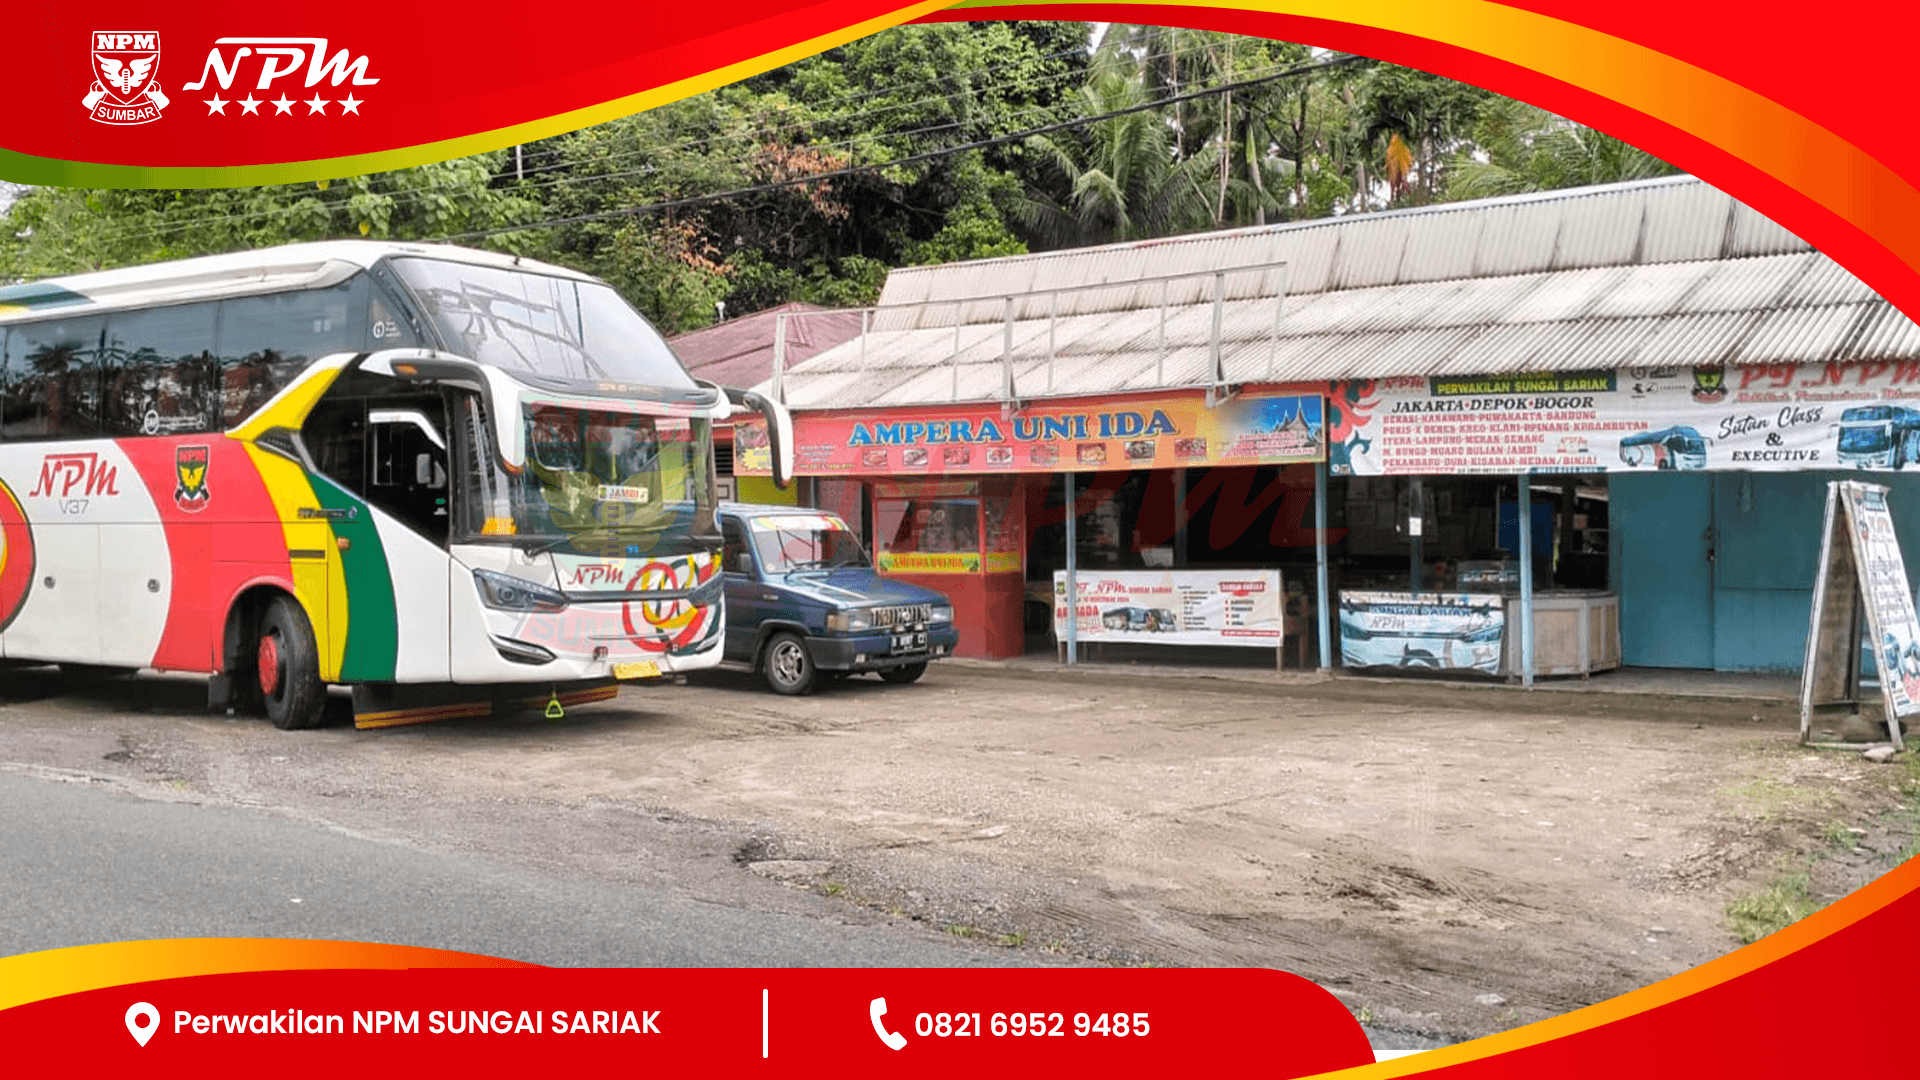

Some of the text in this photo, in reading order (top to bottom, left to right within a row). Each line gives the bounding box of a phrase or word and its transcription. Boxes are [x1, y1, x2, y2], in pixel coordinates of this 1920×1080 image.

[1437, 379, 1608, 394] PERWAKILAN SUNGAI SARIAK
[847, 409, 1179, 447] AMPERA UNI IDA
[1717, 406, 1824, 440] Sutan Class
[1765, 432, 1784, 447] &
[1732, 450, 1820, 461] EXECUTIVE
[29, 452, 120, 498] NPM
[58, 499, 90, 515] V37
[567, 564, 625, 585] NPM
